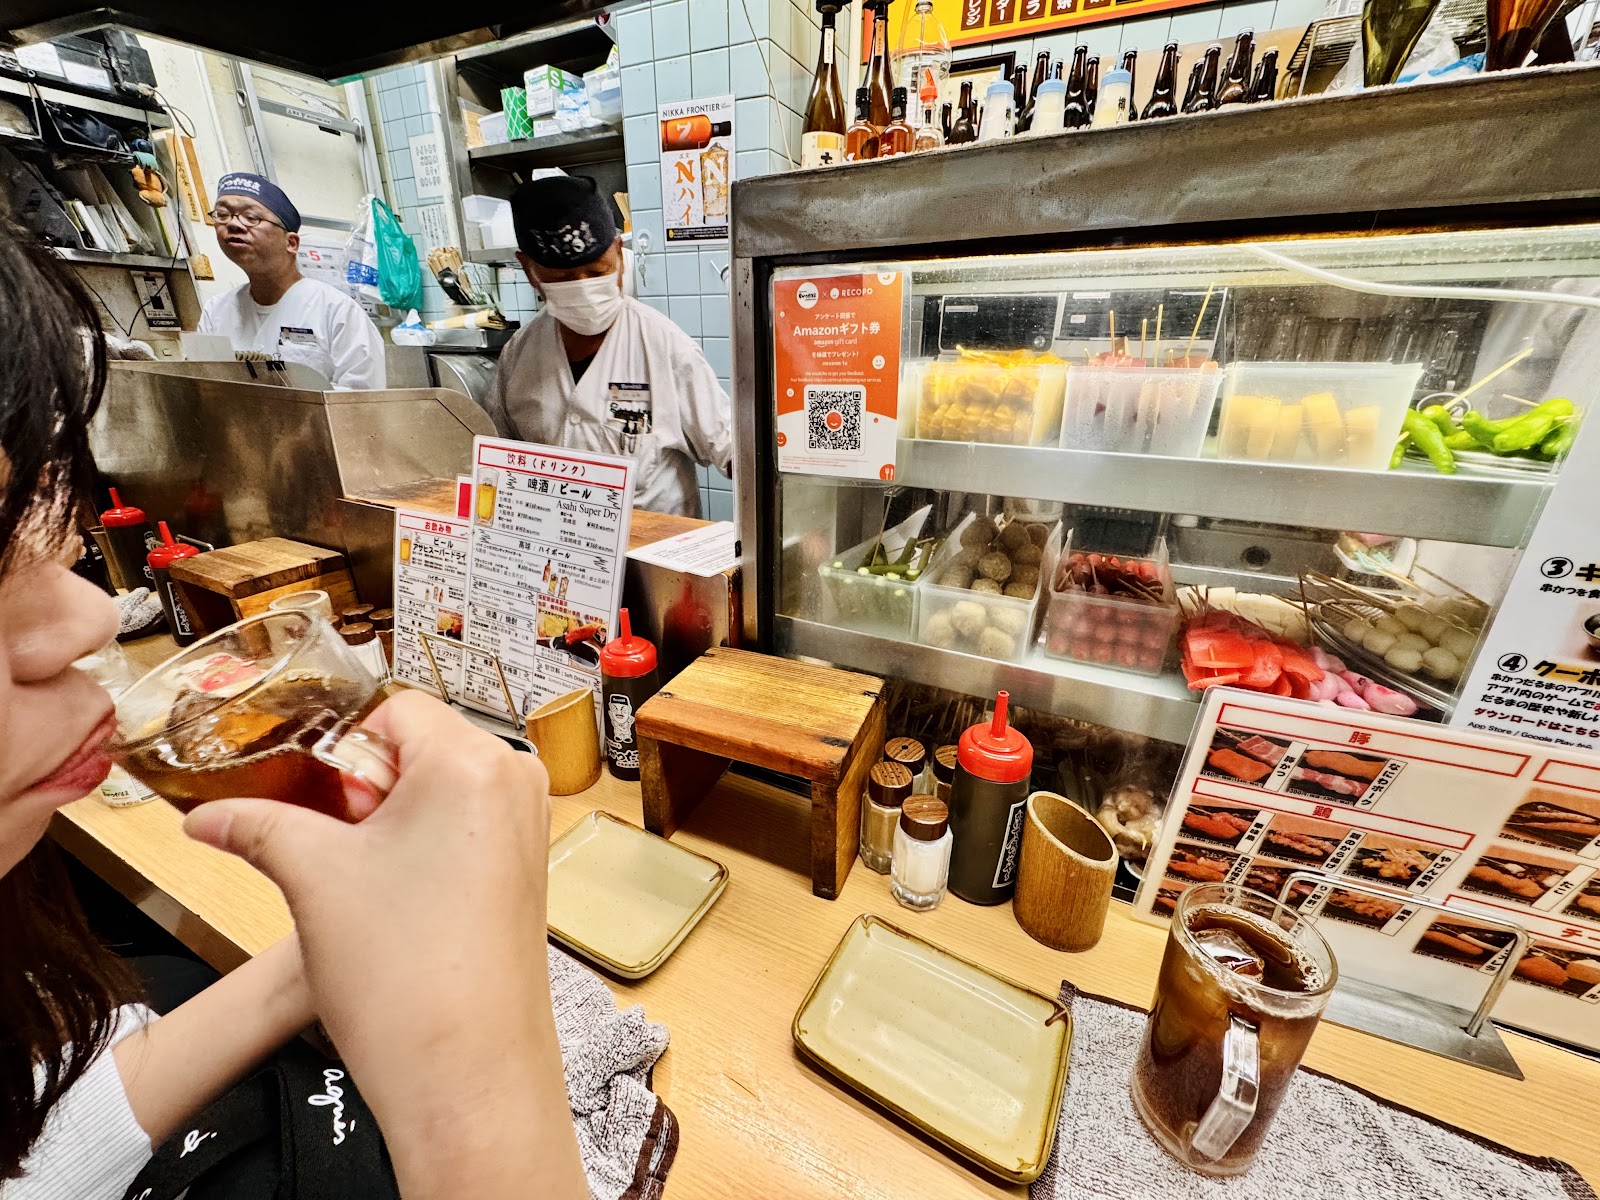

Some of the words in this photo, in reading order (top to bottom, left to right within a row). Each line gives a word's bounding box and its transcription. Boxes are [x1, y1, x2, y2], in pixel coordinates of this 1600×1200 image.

[550, 70, 560, 87] S
[663, 108, 684, 117] NIKKA
[686, 103, 720, 115] FRONTIER
[309, 250, 320, 262] 5
[842, 288, 873, 296] RECOPO
[815, 312, 856, 320] アンケート回答で
[793, 322, 880, 336] Amazonギフト券
[528, 478, 550, 494] 啤酒
[559, 484, 592, 500] ビール
[556, 500, 578, 512] Asahi
[578, 504, 602, 518] Super
[603, 508, 619, 522] Dry
[425, 522, 452, 534] お飲み物
[433, 538, 454, 548] ビール
[413, 543, 467, 561] アサヒスーパードライ
[538, 545, 571, 559] ハイボール
[1468, 721, 1486, 730] App
[1488, 725, 1512, 735] Store
[1474, 707, 1600, 738] ダウンロードはこちら
[1349, 731, 1372, 744] 豚
[1276, 755, 1295, 777] 豚かつ
[1361, 763, 1401, 806] なにわポーク
[1312, 806, 1332, 818] 鶏
[1325, 832, 1362, 869] 鶏のから揚げ
[1416, 855, 1452, 888] やげん軟骨
[1561, 928, 1600, 943] チー
